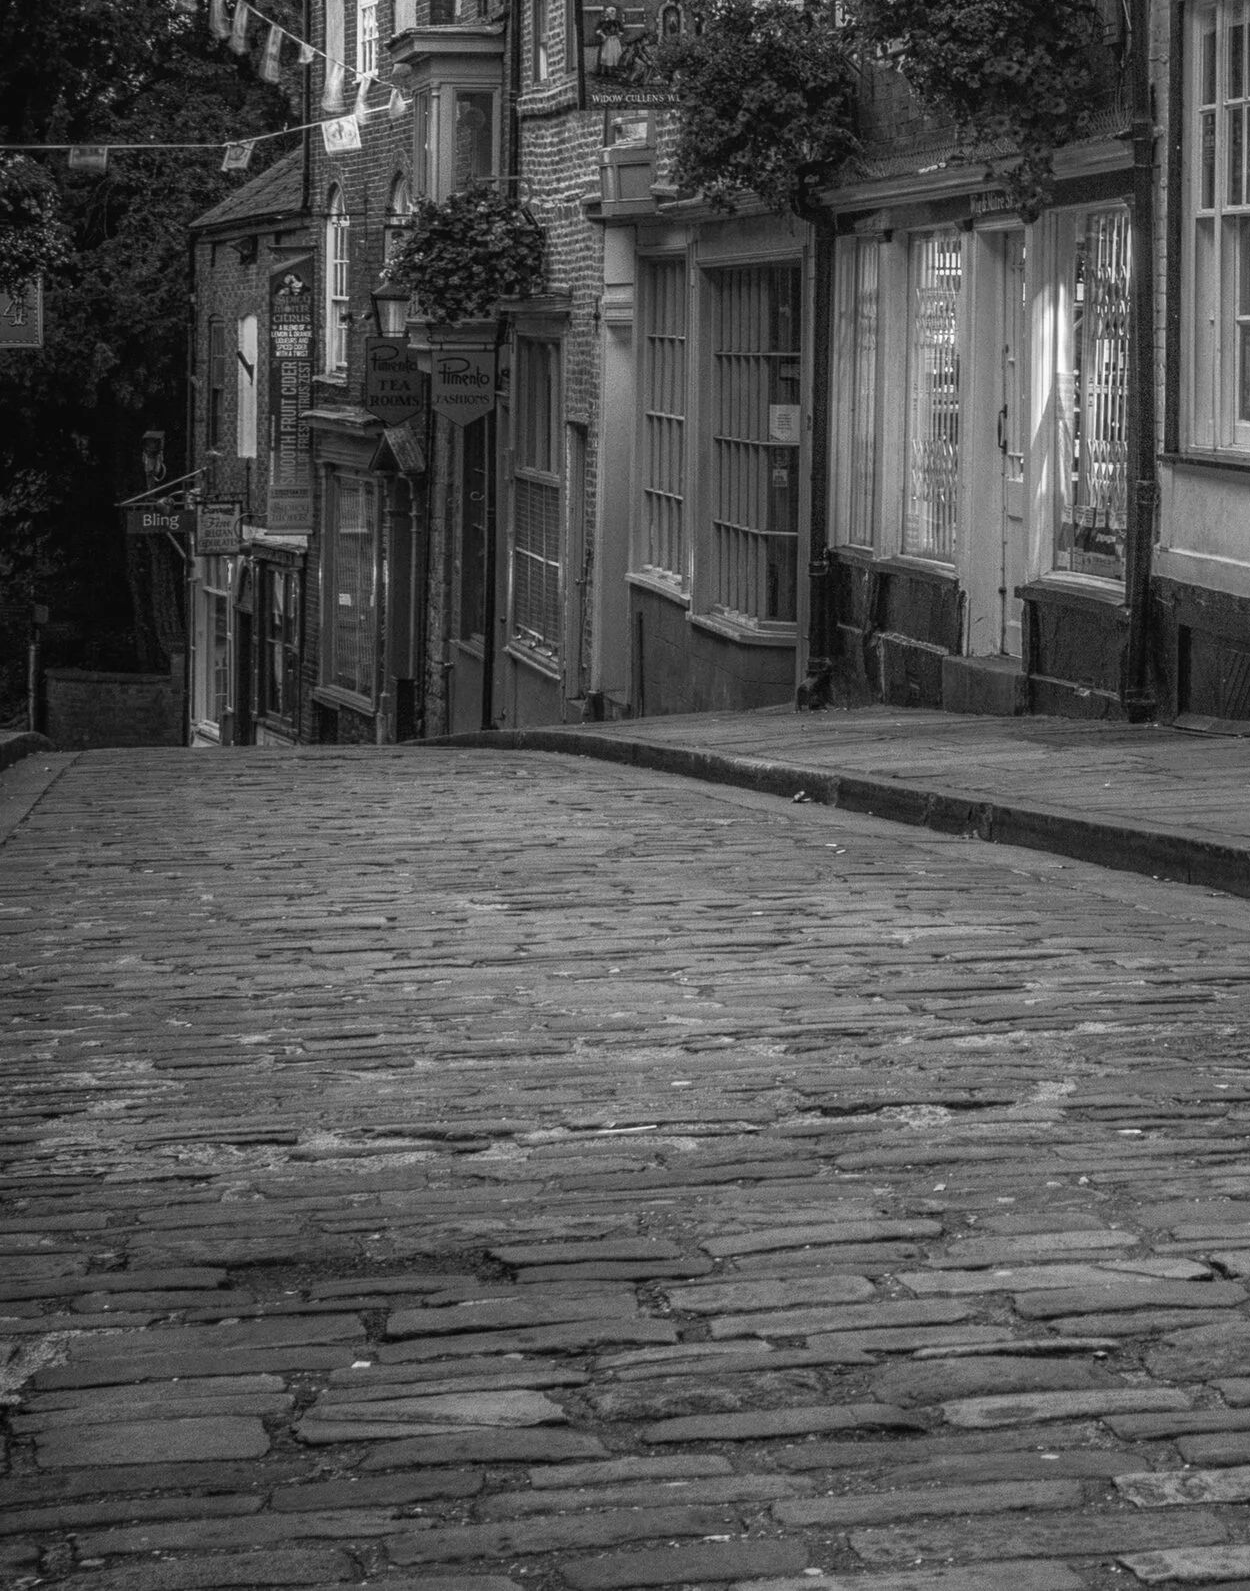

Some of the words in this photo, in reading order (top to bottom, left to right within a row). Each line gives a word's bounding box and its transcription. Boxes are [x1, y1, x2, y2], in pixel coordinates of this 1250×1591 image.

[592, 94, 622, 103] WIDOW
[625, 94, 664, 103] CULLENS
[272, 313, 311, 323] CITRUS
[281, 361, 298, 395] CIDER
[298, 361, 311, 384] ZEST
[437, 357, 490, 388] Pimento
[380, 379, 411, 391] TEA
[370, 395, 420, 407] ROOMS
[436, 394, 490, 405] FASHIONS
[280, 398, 297, 432] FRUIT
[280, 435, 297, 485] SMOOTH
[143, 513, 180, 529] Bling
